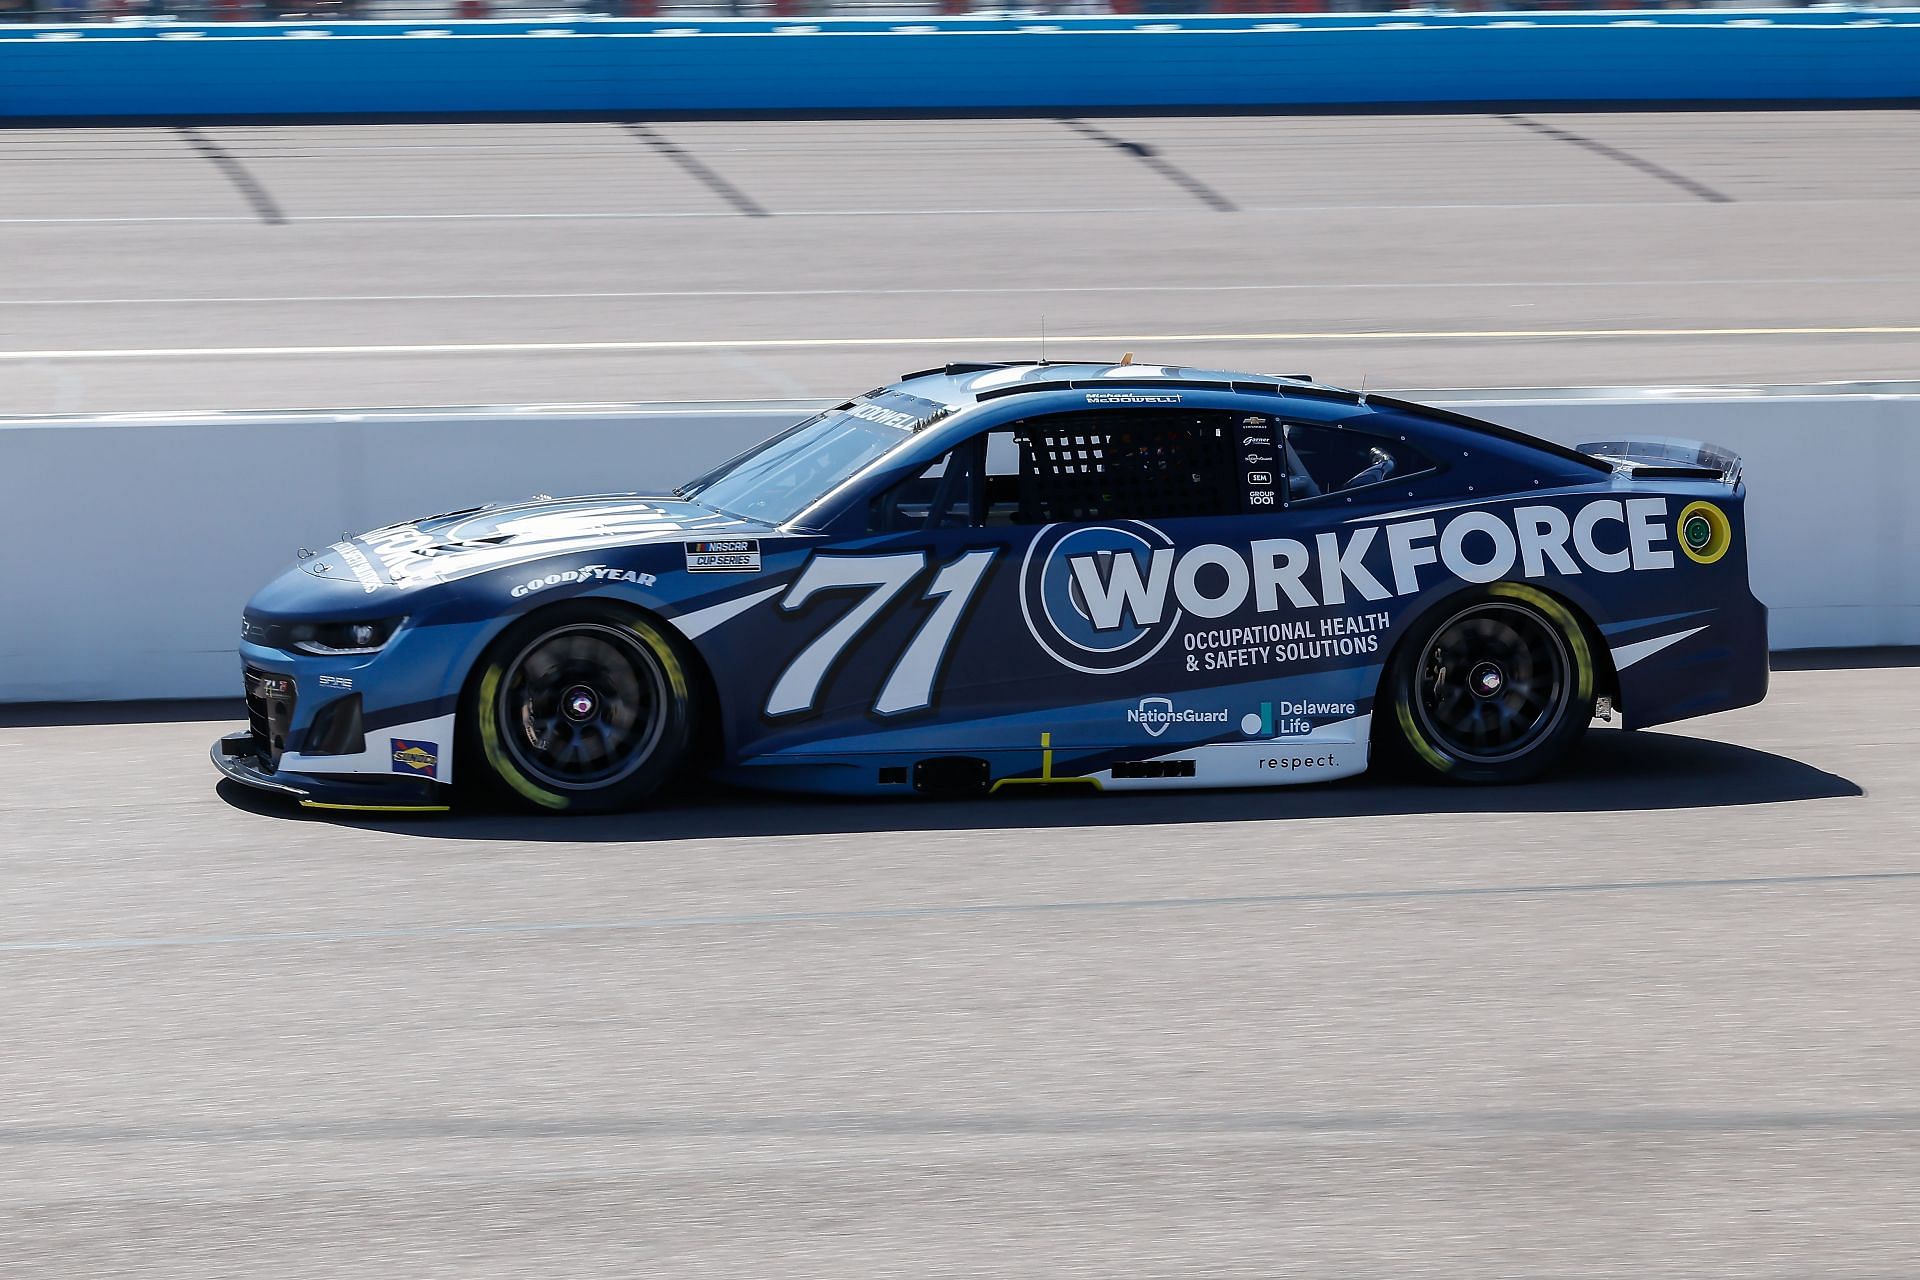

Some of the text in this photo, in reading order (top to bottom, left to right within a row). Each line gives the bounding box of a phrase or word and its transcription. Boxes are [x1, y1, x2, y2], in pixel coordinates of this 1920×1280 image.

[1250, 496, 1274, 504] 1001
[709, 541, 748, 552] NASCAR
[697, 554, 751, 565] CUP SERIES
[1071, 497, 1675, 631] WORKFORCE
[510, 565, 657, 598] GOODYEAR
[764, 549, 997, 717] 71
[1184, 611, 1390, 650] OCCUPATIONAL HEALTH
[1186, 634, 1379, 672] & SAFETY SOLUTIONS
[1127, 708, 1228, 723] NationsGuard
[1280, 701, 1355, 715] Delaware
[1280, 718, 1310, 734] Life
[1259, 753, 1339, 771] respect.
